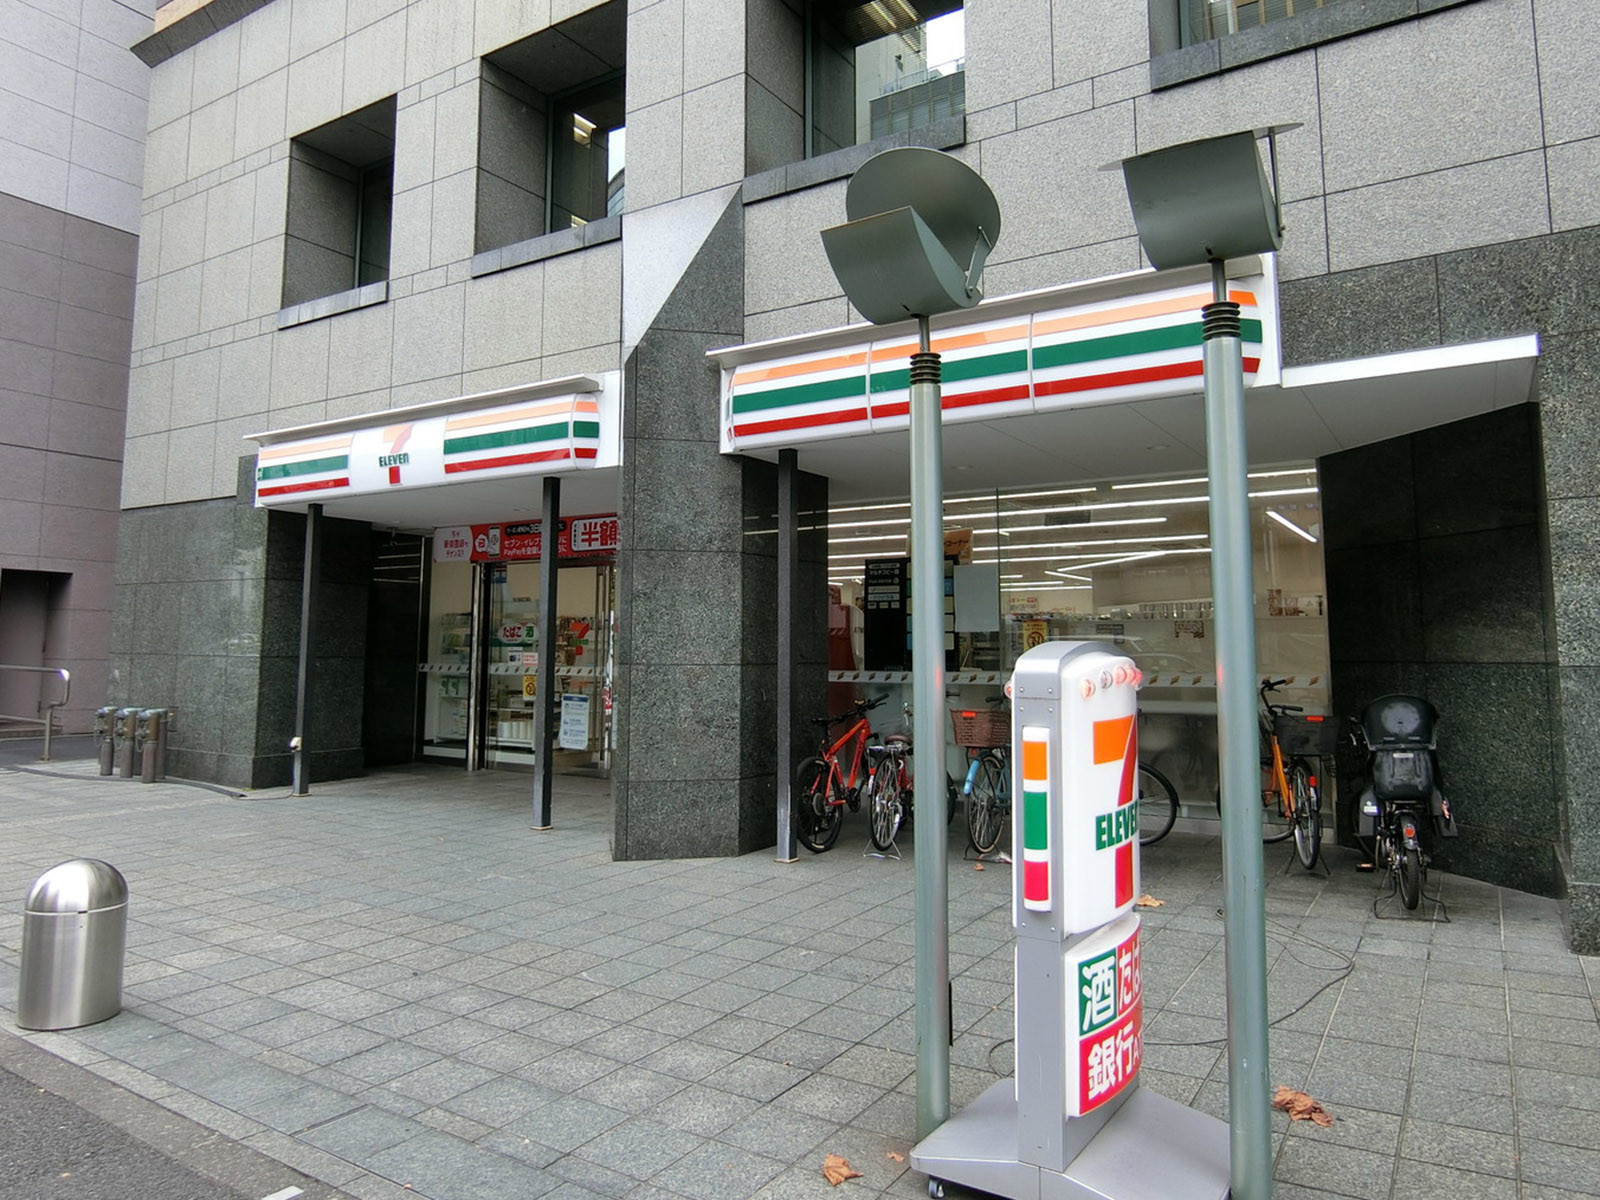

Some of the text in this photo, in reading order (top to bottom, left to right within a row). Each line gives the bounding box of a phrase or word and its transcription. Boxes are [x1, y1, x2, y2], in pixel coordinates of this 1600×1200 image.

[503, 626, 522, 639] たばこ
[1095, 801, 1138, 851] ELEVE
[1082, 954, 1117, 1032] 酒
